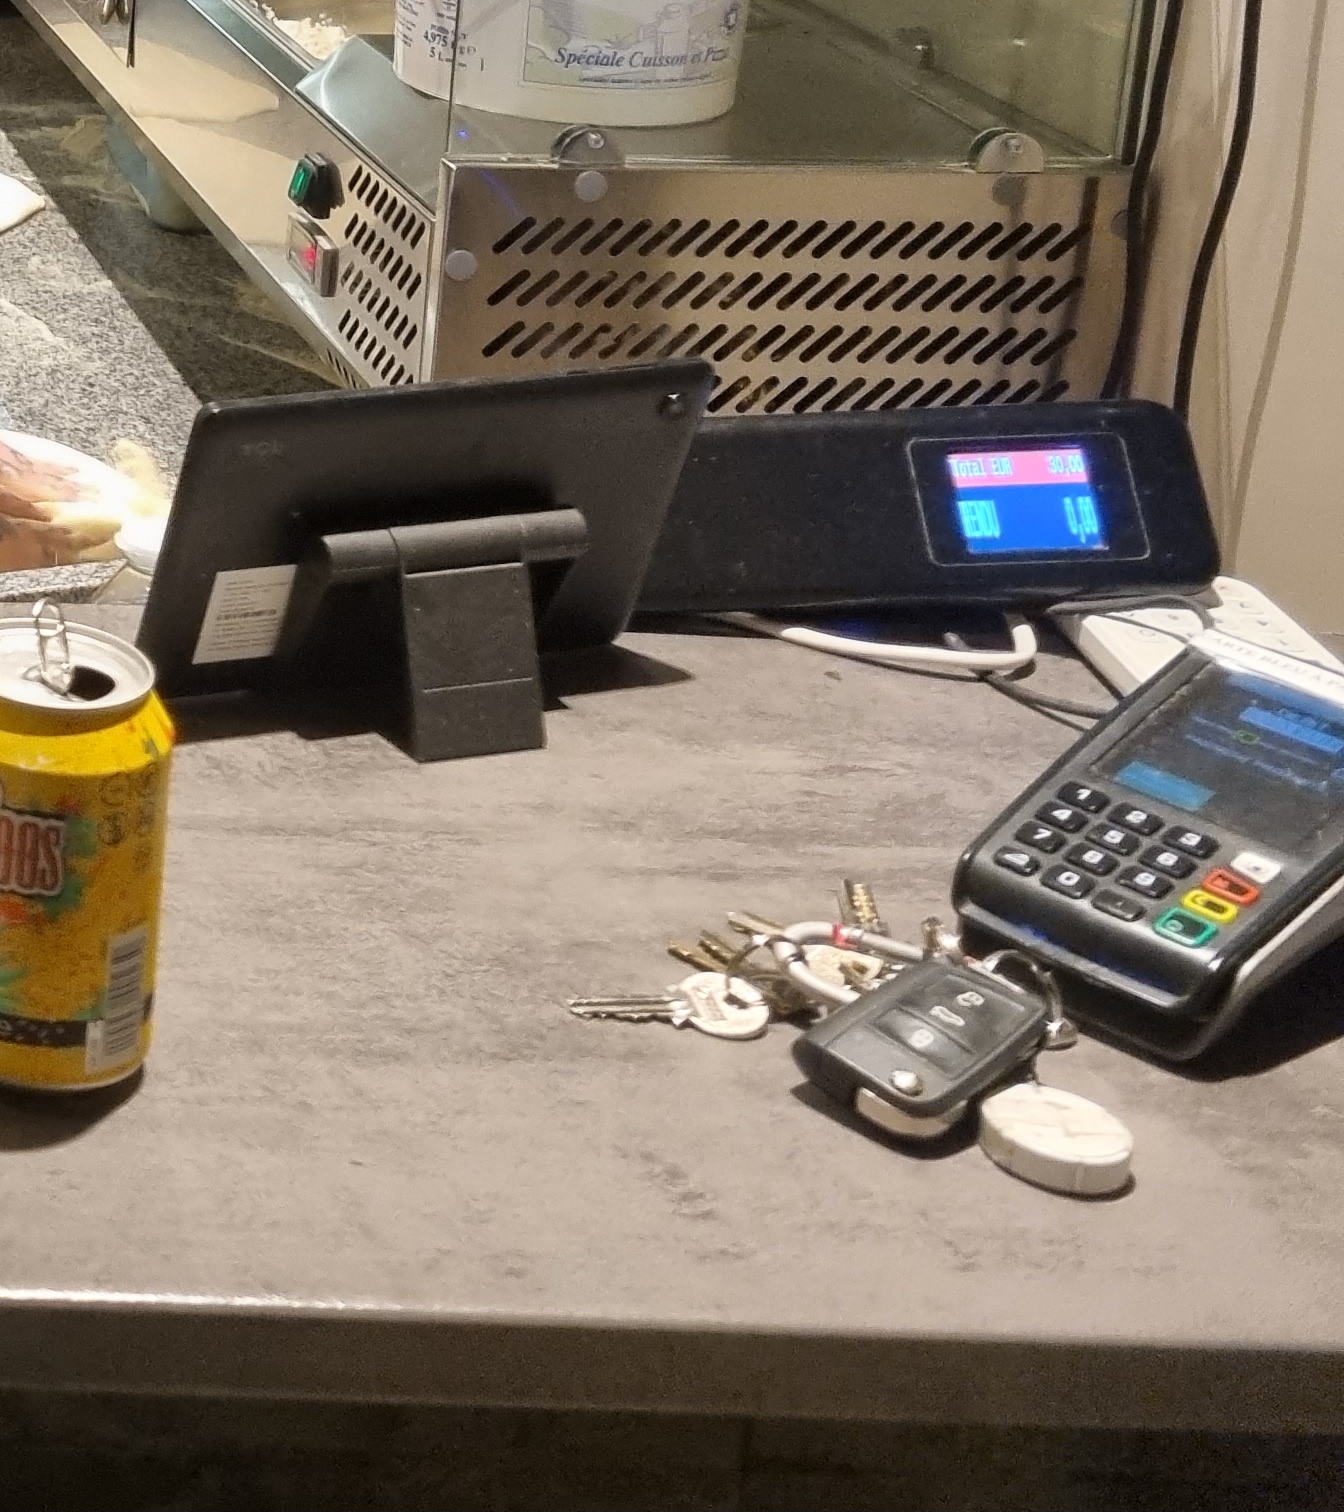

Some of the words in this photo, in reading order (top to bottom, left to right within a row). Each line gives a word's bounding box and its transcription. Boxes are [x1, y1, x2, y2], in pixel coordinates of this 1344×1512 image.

[555, 46, 624, 69] Spéciale
[948, 458, 985, 477] Total
[990, 456, 1013, 476] EUR
[1063, 495, 1099, 545] 0,00
